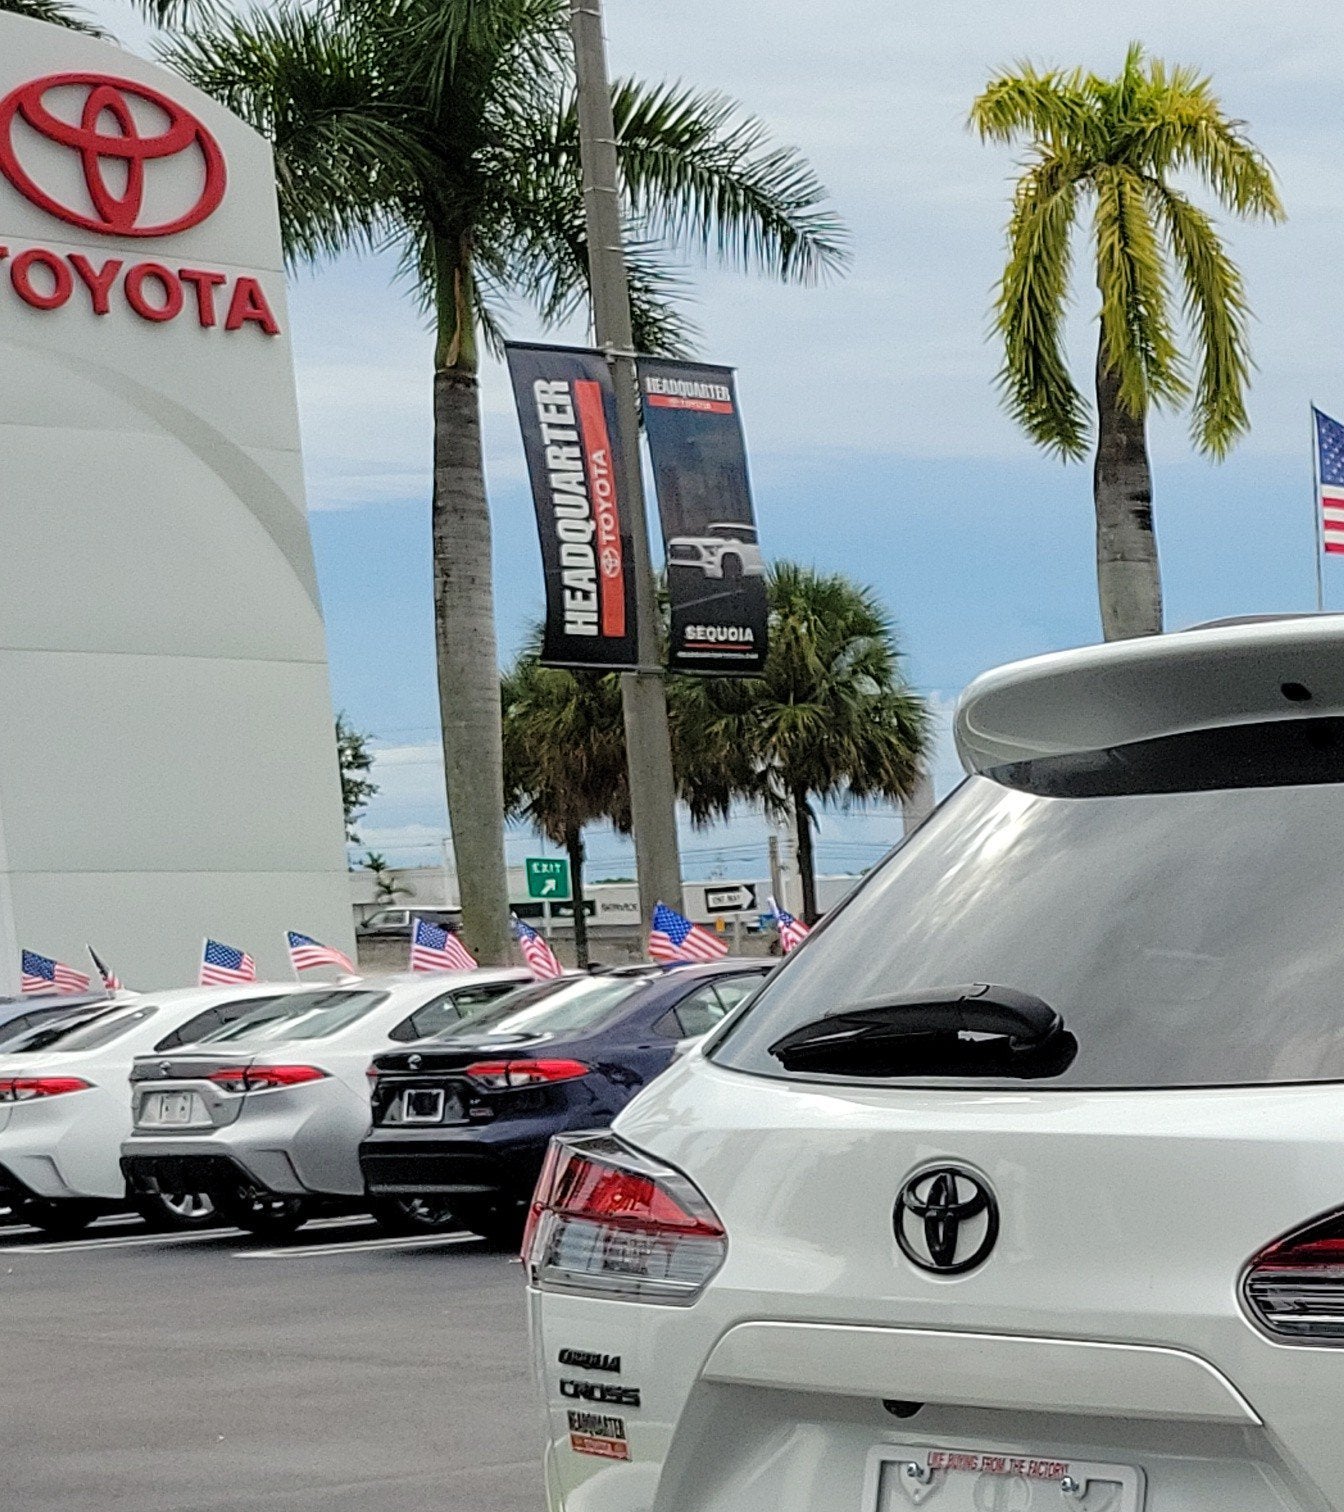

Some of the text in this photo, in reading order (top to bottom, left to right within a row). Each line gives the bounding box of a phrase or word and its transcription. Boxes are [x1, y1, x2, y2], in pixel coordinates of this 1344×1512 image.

[646, 375, 731, 402] HEADQUARTER
[534, 378, 599, 637] HEADQUARTER
[590, 449, 618, 545] TOYOTA
[684, 624, 755, 643] SEQUOIA
[532, 861, 562, 874] EXIT
[559, 1378, 641, 1407] CROSS
